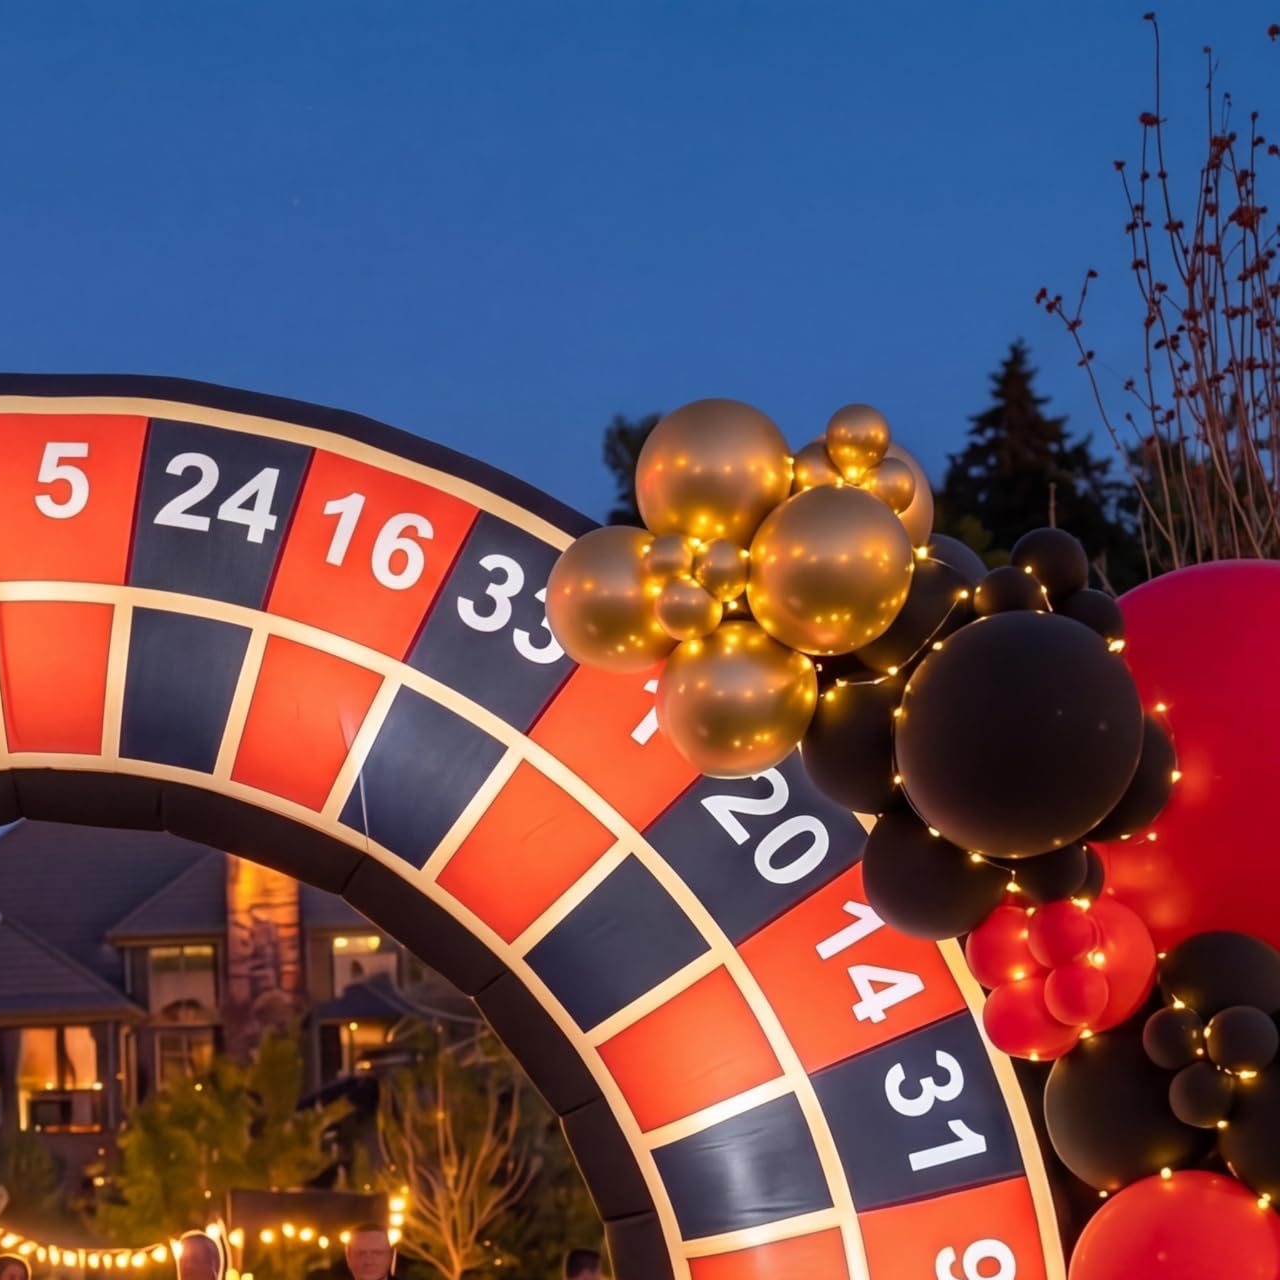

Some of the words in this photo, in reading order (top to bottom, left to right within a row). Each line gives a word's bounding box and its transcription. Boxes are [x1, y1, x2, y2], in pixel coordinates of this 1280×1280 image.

[35, 443, 89, 518] 5
[153, 452, 280, 544] 24
[324, 493, 433, 590] 16
[700, 766, 830, 885] 20
[815, 900, 925, 1024] 14
[884, 1049, 987, 1172] 31
